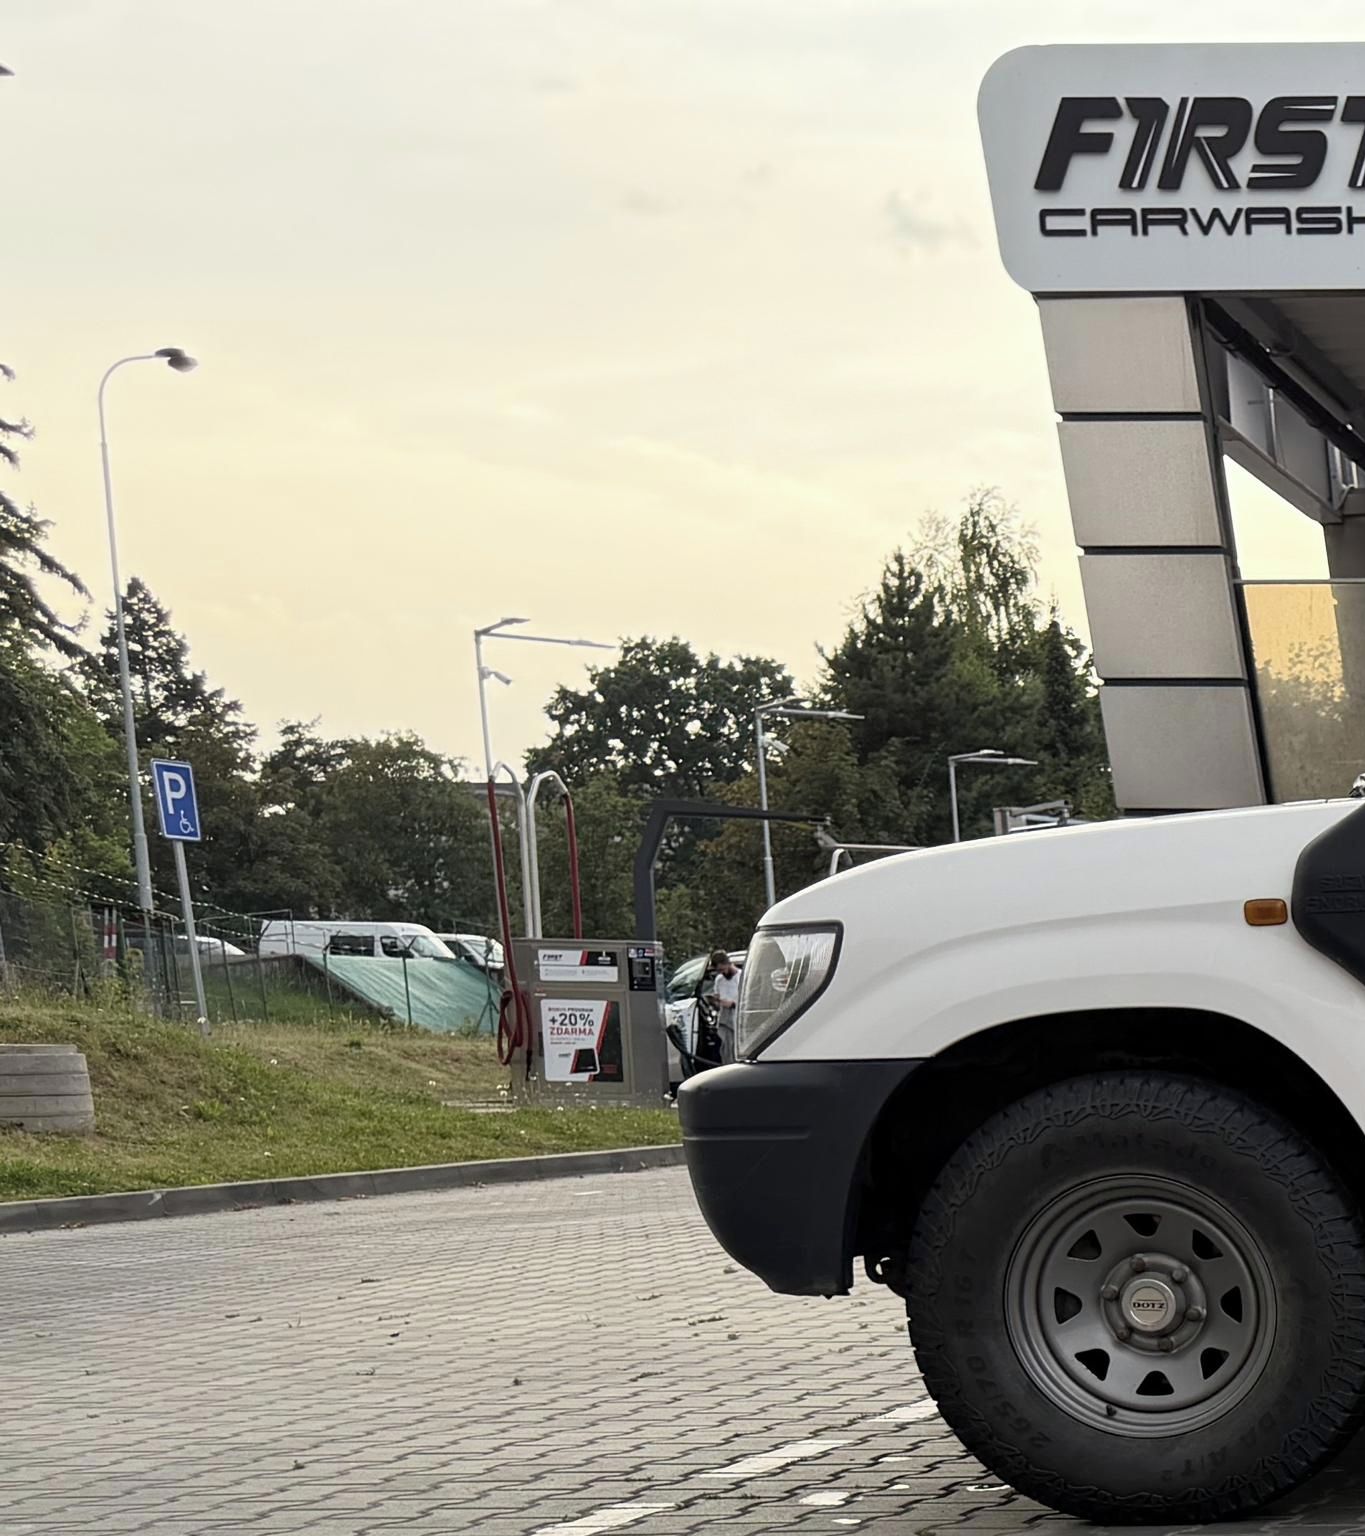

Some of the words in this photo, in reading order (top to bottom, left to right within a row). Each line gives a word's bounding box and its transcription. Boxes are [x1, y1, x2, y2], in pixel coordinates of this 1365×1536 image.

[162, 771, 187, 815] P
[549, 1012, 594, 1027] +20%
[549, 1027, 595, 1036] ZDARMA
[1132, 1301, 1166, 1309] DOTZ
